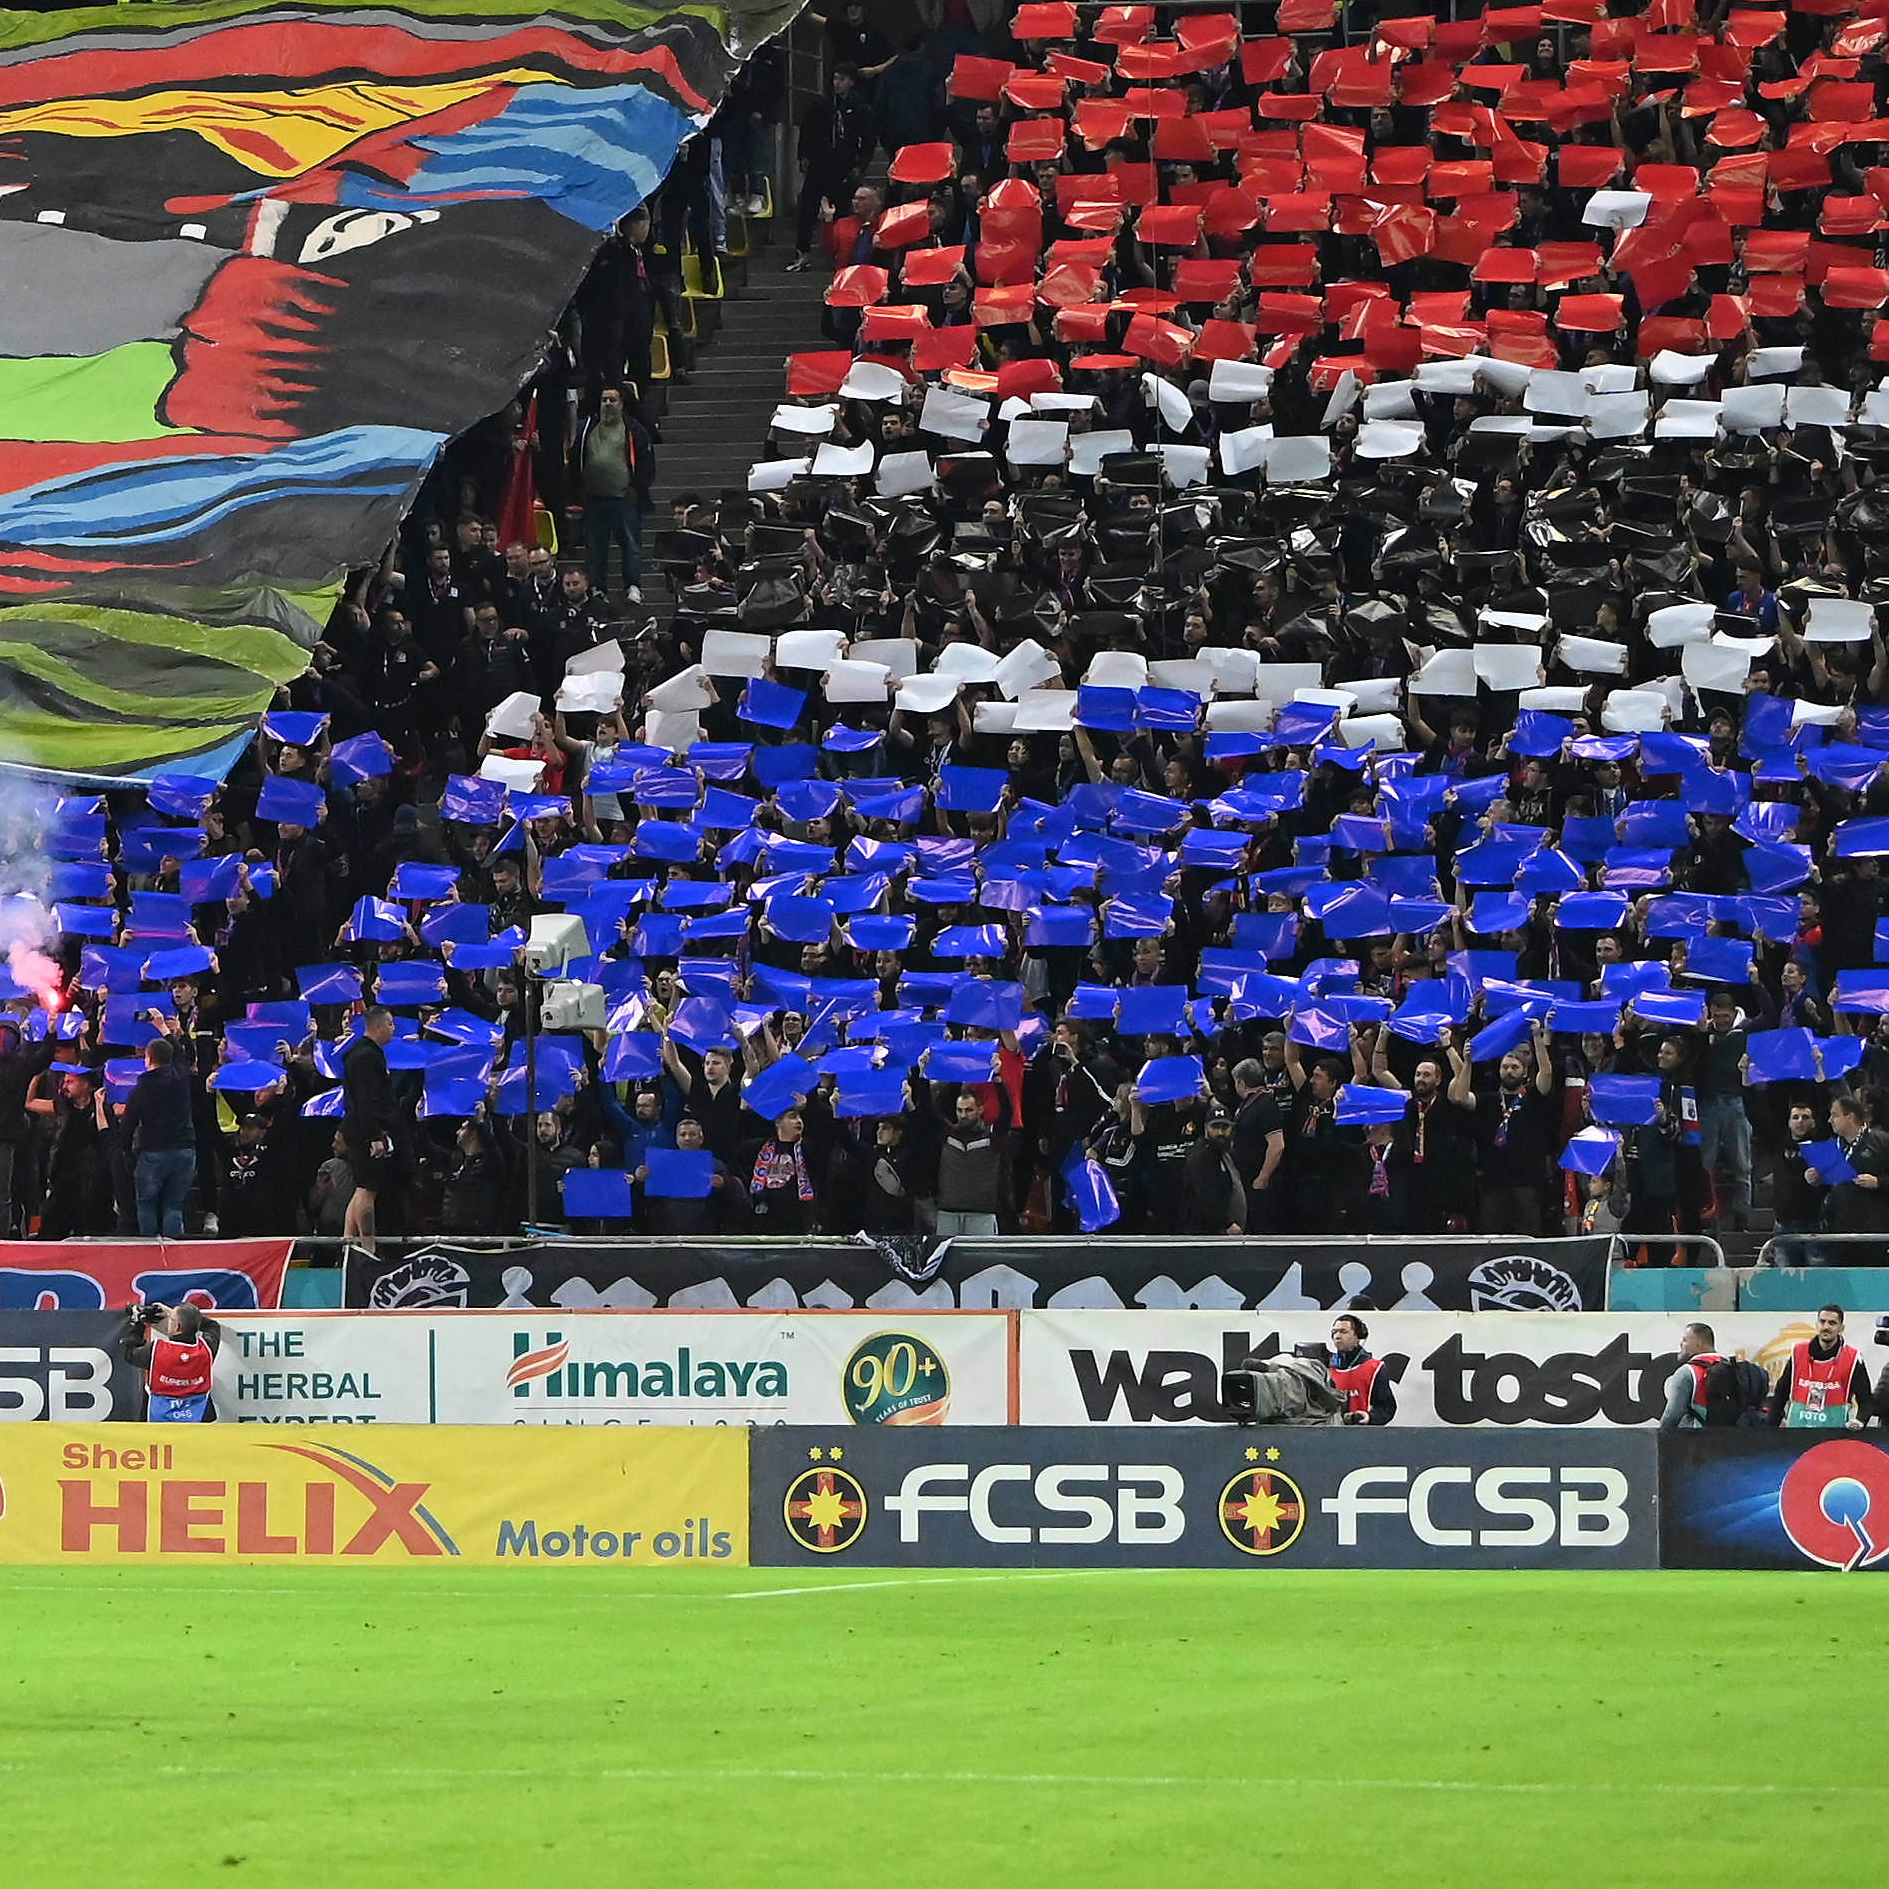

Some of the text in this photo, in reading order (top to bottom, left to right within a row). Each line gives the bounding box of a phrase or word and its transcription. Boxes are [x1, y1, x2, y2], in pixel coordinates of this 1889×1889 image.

[238, 1332, 304, 1357] THE
[507, 1331, 789, 1398] Himalaya
[238, 1374, 382, 1399] HERBAL
[1799, 1411, 1827, 1422] FOTO
[63, 1443, 174, 1470] Shell
[57, 1479, 443, 1556] HELIX
[884, 1463, 1186, 1543] FCSB
[1322, 1465, 1630, 1547] FCSB
[496, 1518, 733, 1558] Motor oils
